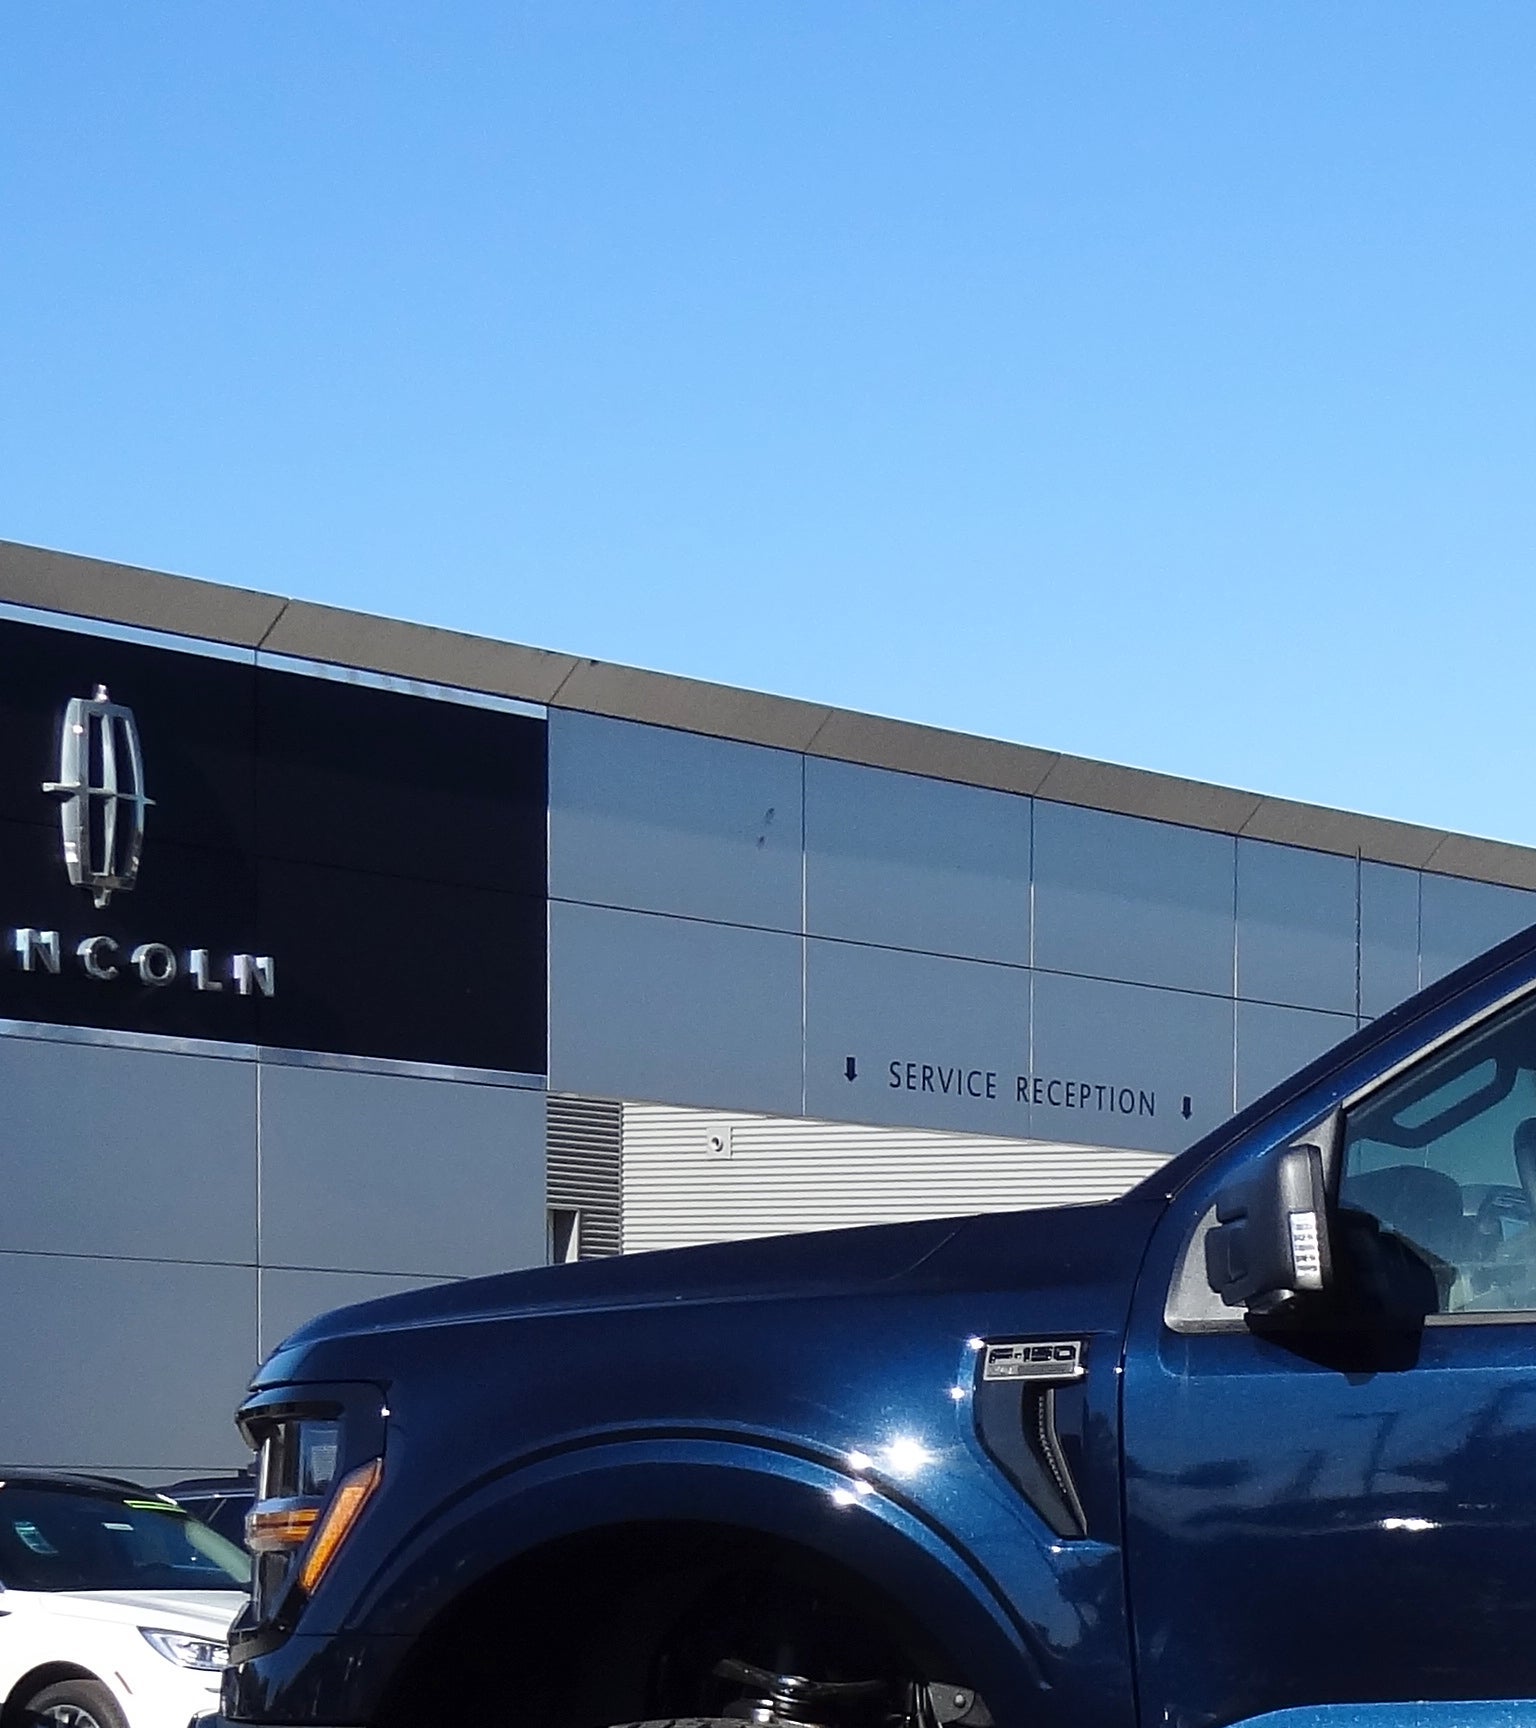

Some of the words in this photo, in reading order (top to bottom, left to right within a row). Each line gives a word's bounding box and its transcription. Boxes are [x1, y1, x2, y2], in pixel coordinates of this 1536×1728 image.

[15, 928, 275, 997] NCOLN
[888, 1060, 998, 1099] SERVICE
[1016, 1076, 1156, 1117] RECEPTION
[988, 1345, 1077, 1365] F-150
